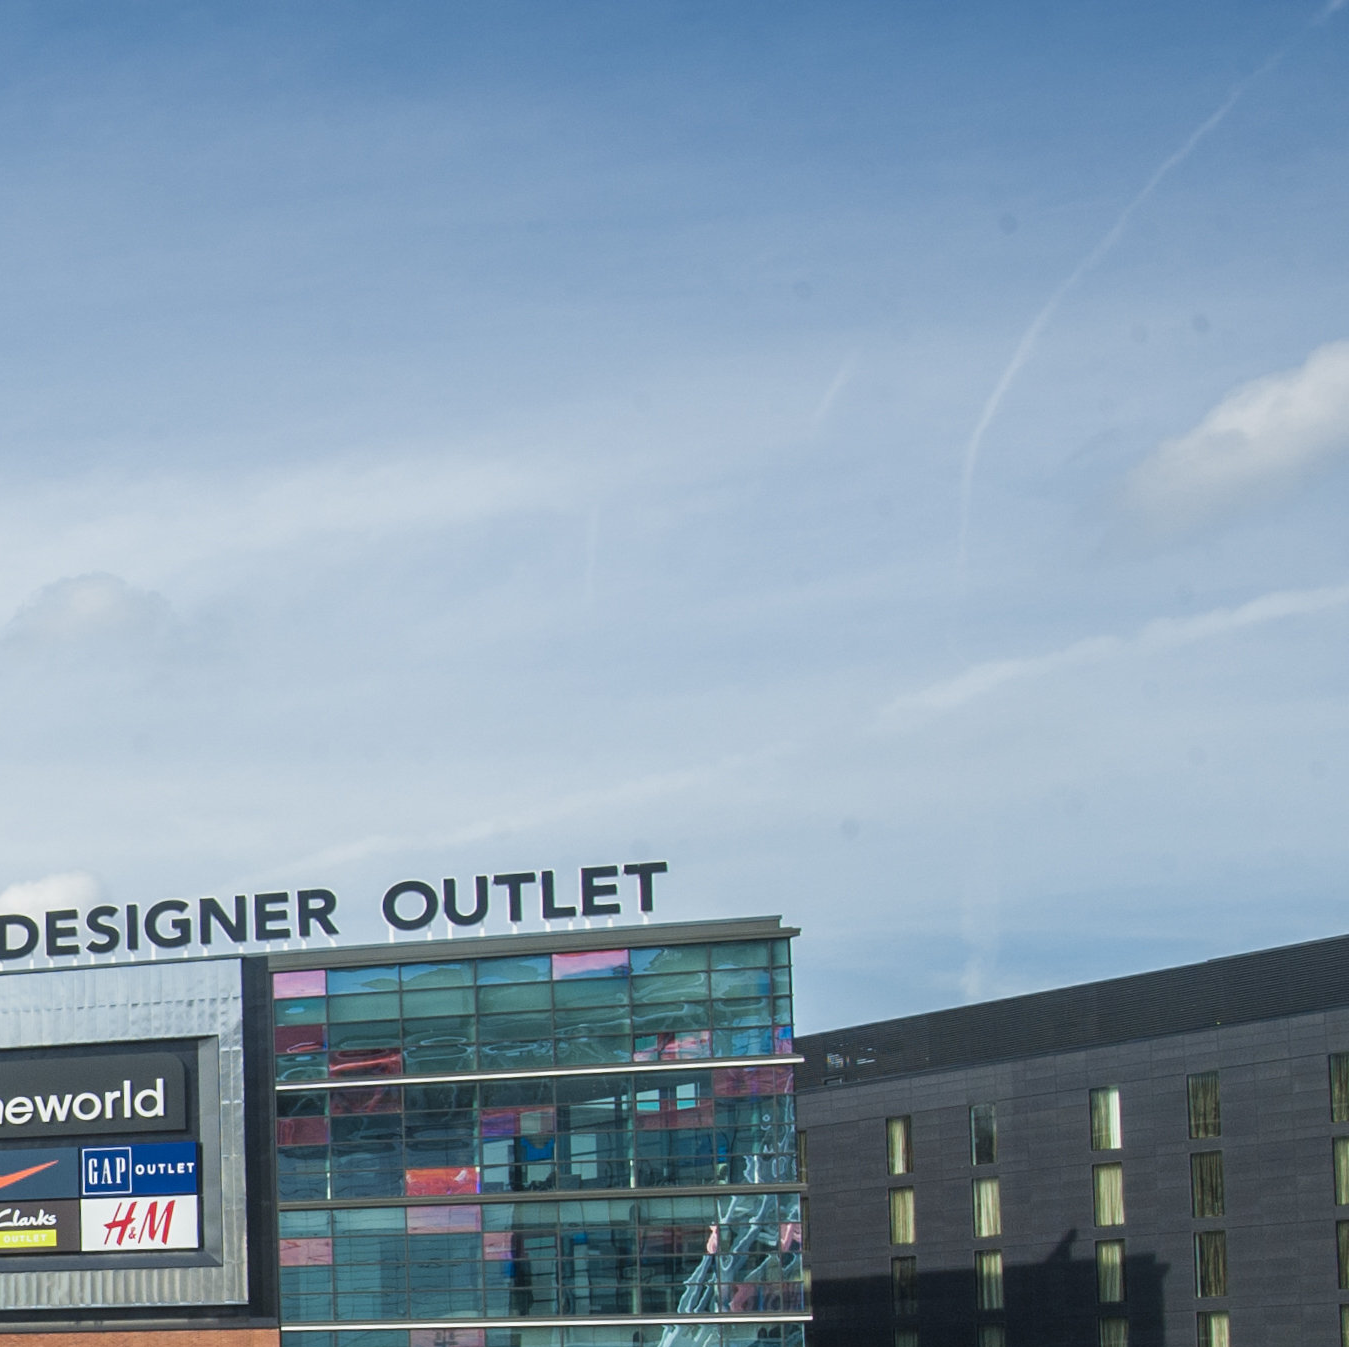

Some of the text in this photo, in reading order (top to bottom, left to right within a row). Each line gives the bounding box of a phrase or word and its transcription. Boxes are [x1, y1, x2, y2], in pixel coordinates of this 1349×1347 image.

[381, 861, 668, 932] OUTLET
[88, 1155, 196, 1185] GAP OUTLET
[3, 1233, 47, 1244] OUTLET
[103, 1200, 176, 1246] H&M
